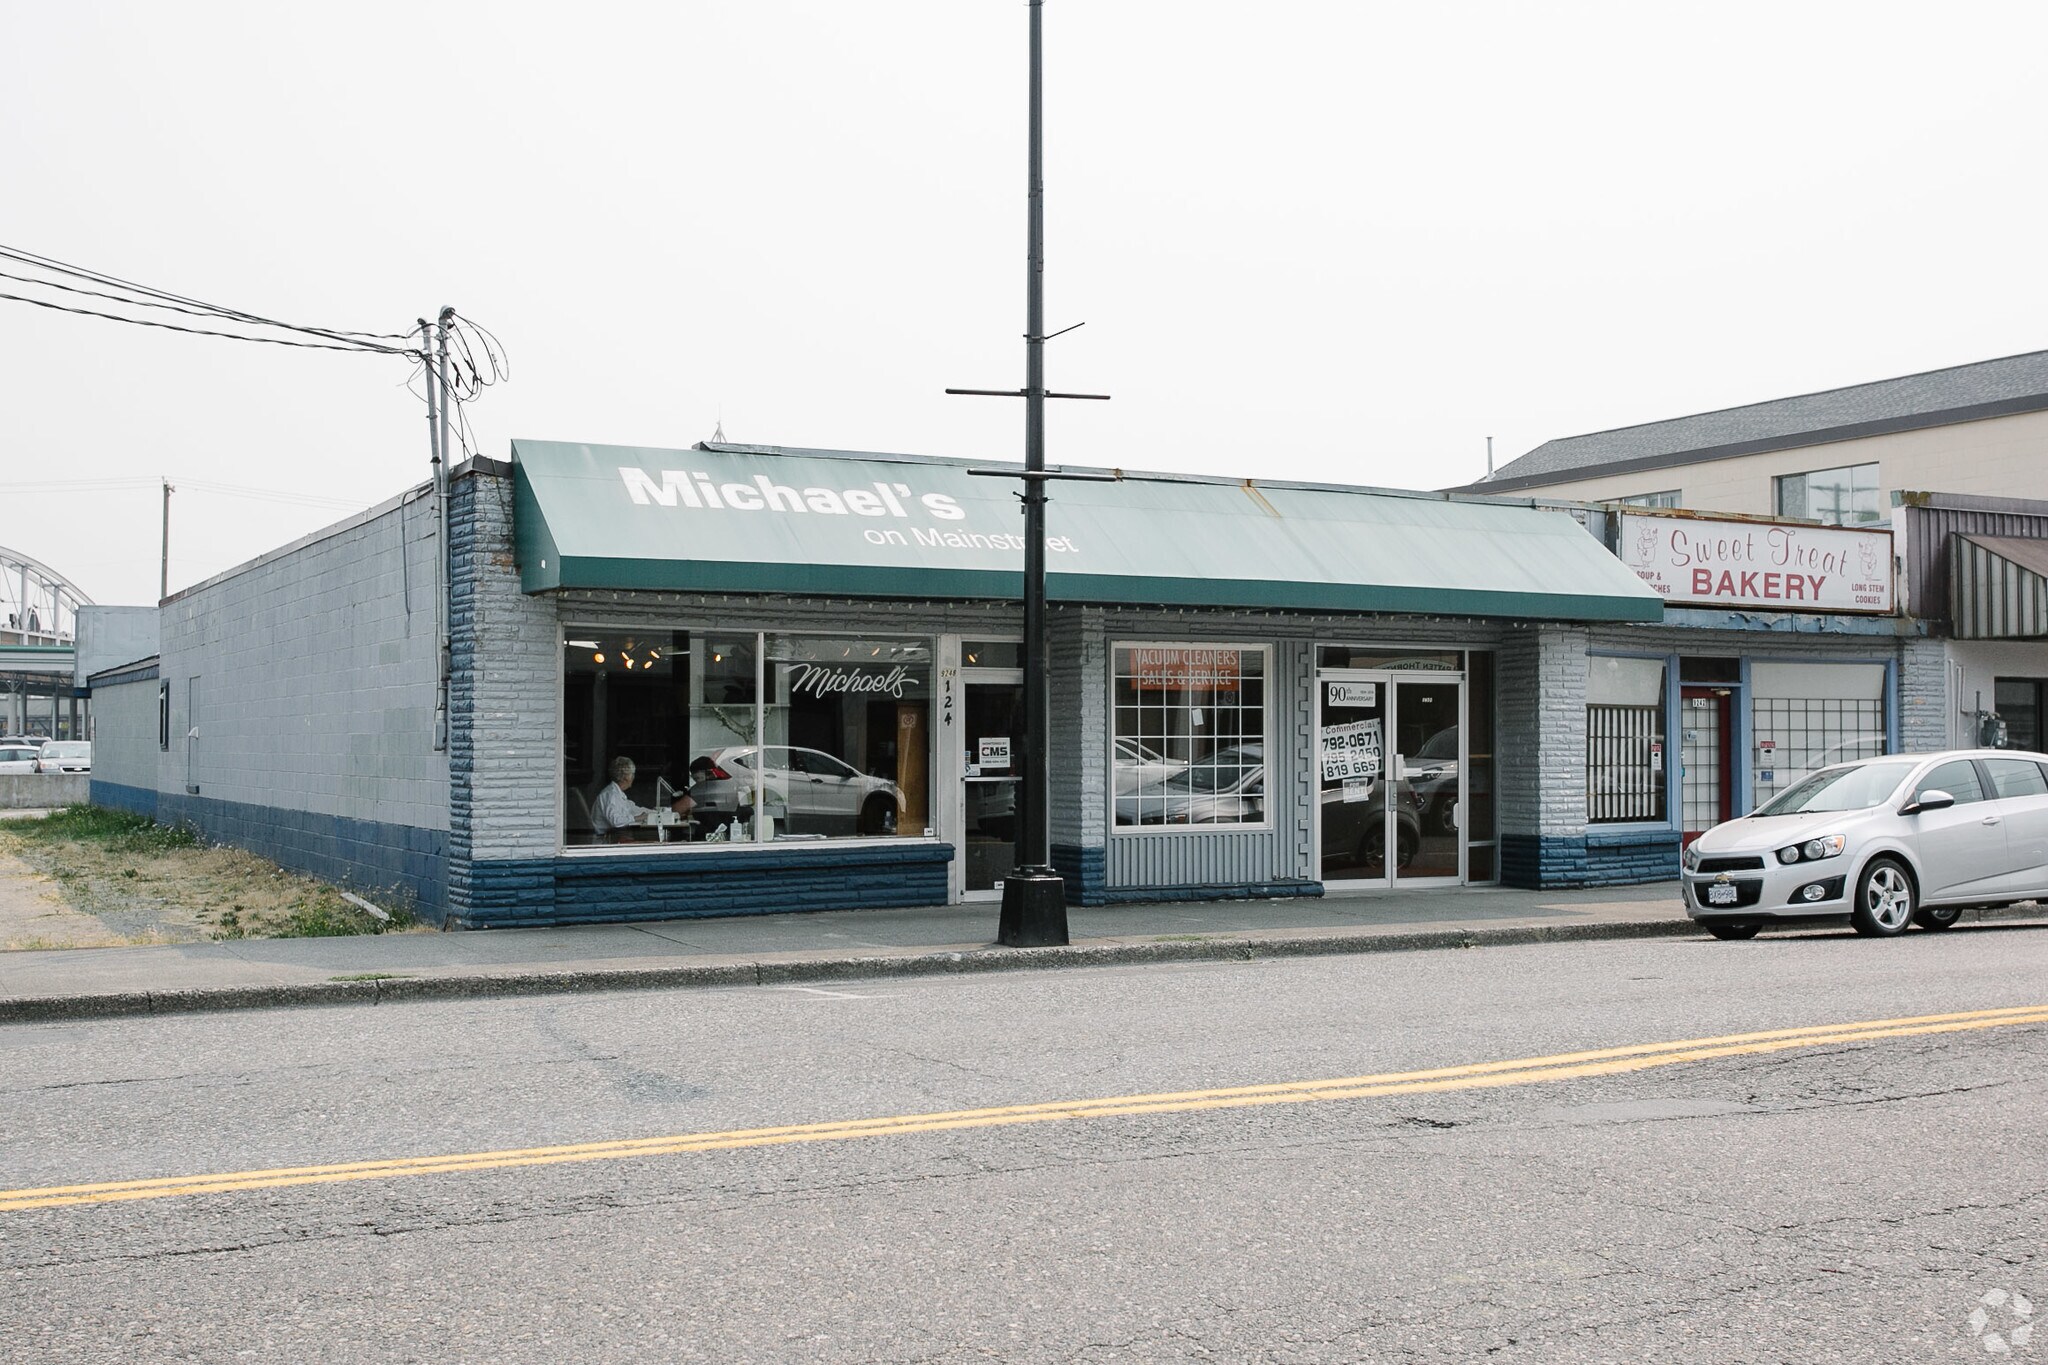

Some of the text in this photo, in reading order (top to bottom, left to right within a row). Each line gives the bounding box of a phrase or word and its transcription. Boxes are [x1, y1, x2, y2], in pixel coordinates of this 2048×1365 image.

[618, 467, 965, 520] Michael's
[864, 526, 1080, 553] on Mainstret
[1670, 527, 1847, 578] Sweet Treat
[1692, 568, 1827, 600] BAKERY
[1851, 583, 1885, 593] LONG STEM
[1855, 595, 1881, 604] COOKIES
[1134, 650, 1237, 666] VACUUM CLEANERS
[1325, 720, 1376, 735] Commercial
[981, 746, 1008, 757] CMS
[1326, 764, 1349, 778] 819
